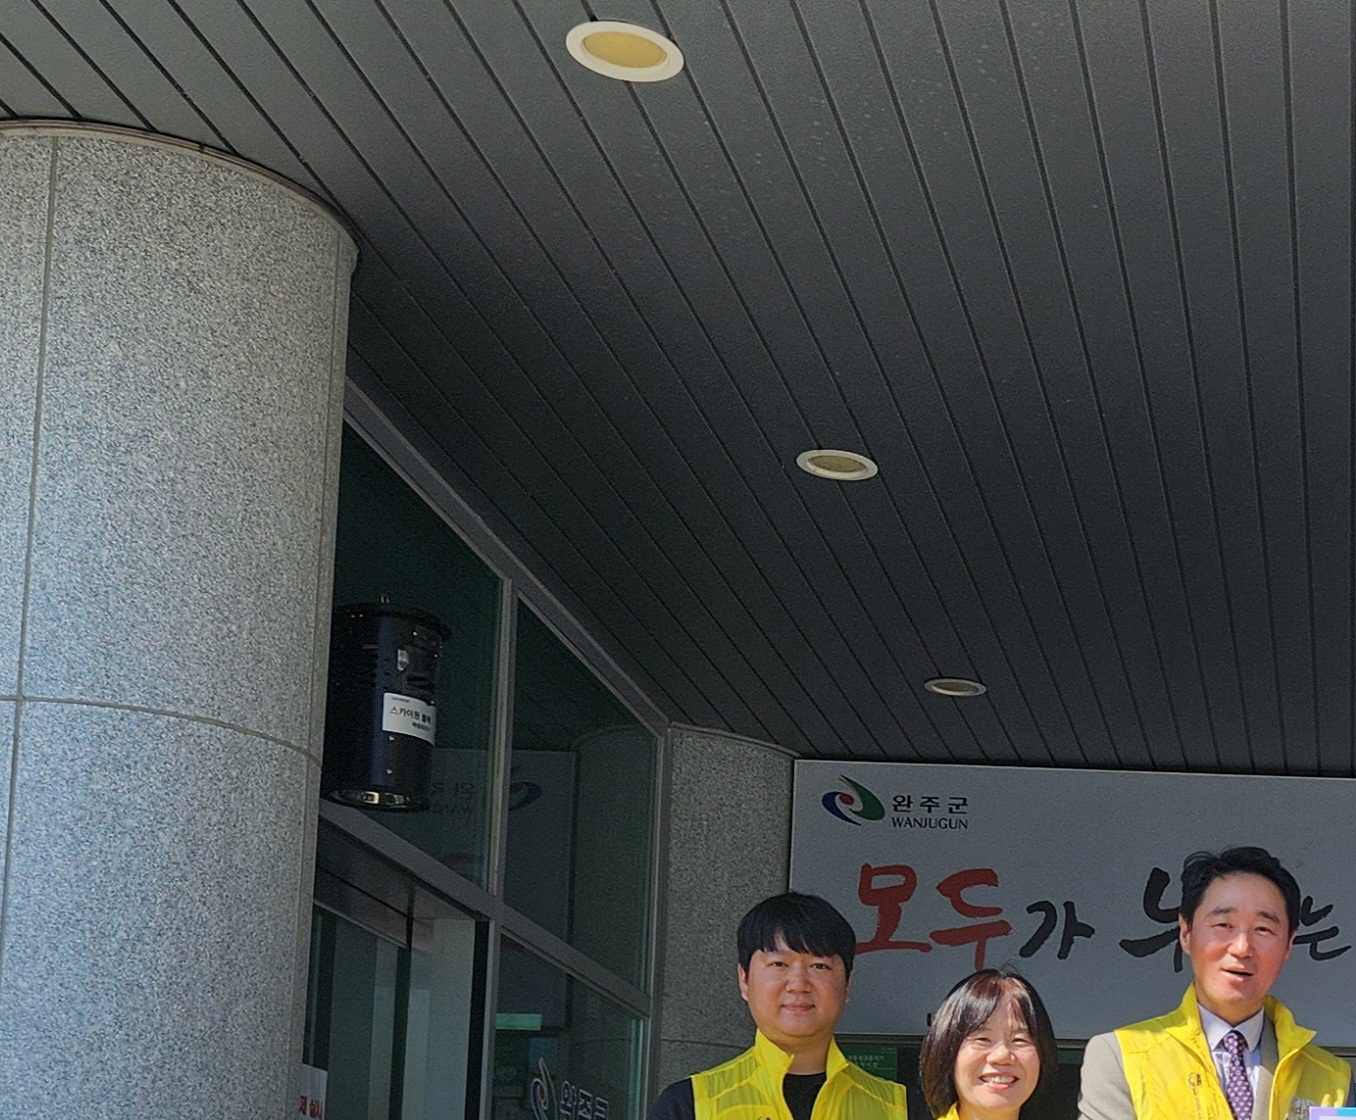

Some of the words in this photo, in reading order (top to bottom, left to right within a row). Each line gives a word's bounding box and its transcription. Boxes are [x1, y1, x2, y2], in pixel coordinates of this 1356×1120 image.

[892, 794, 968, 814] 완주군
[891, 816, 968, 829] WANJUGUN
[855, 864, 1095, 971] 모두가
